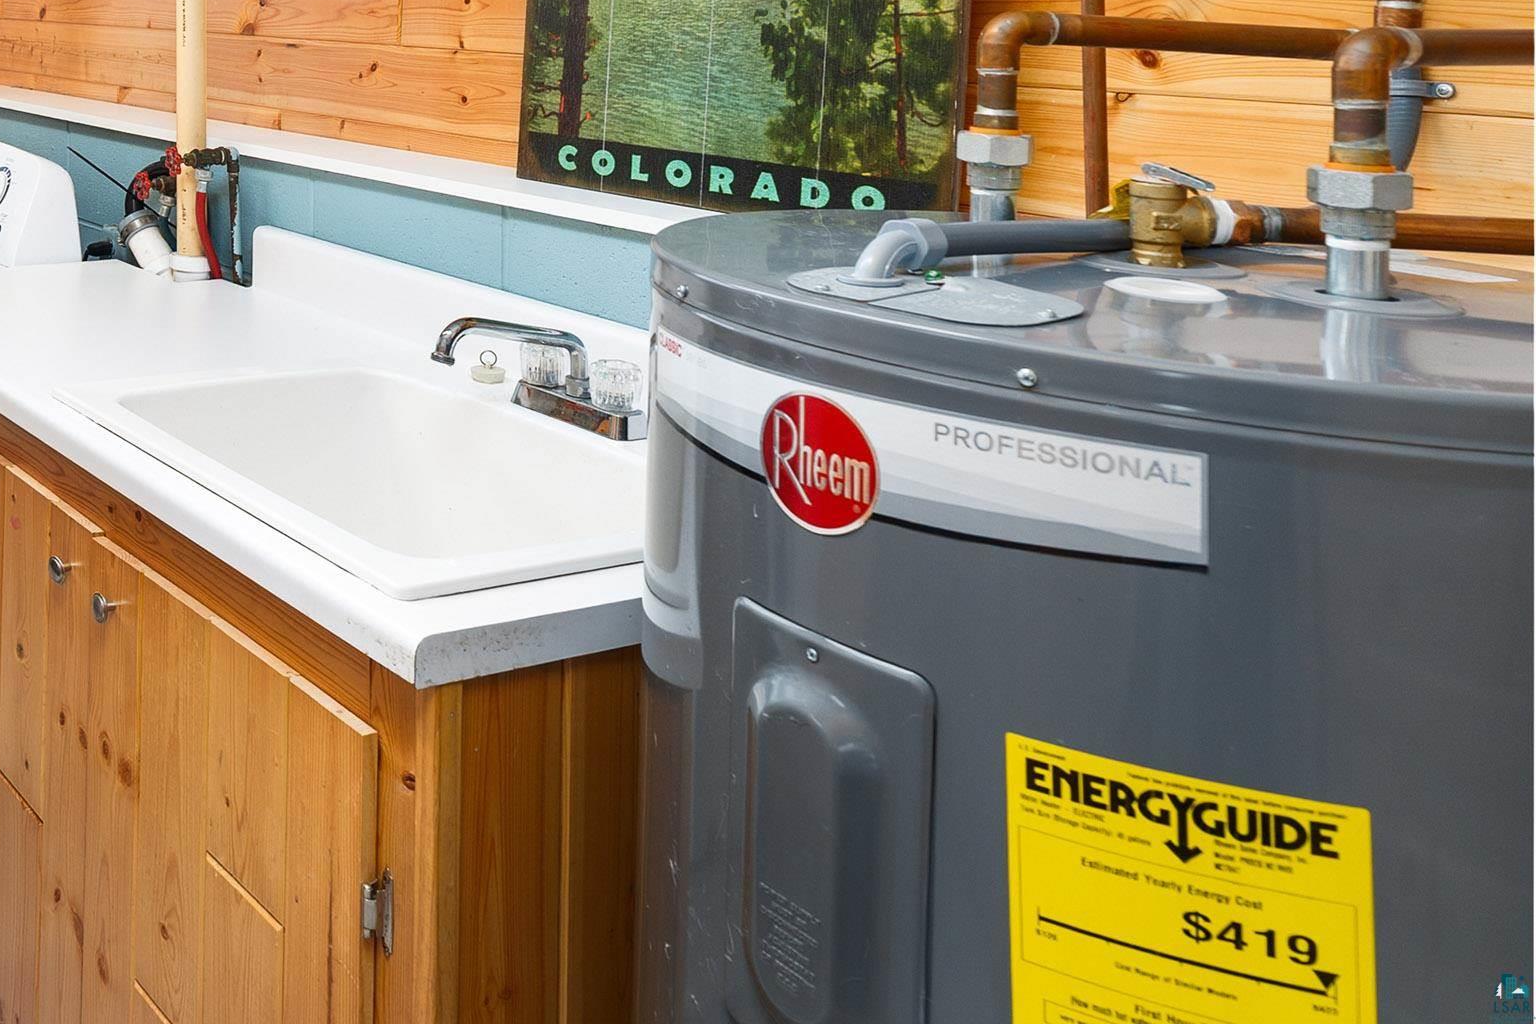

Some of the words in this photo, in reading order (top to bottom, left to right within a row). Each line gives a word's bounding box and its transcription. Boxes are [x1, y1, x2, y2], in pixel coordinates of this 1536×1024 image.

[558, 144, 885, 211] COLORADO
[773, 395, 870, 506] Rheem
[934, 422, 1191, 487] PROFESSIONAL
[1025, 757, 1340, 863] ENERGYGUIDE
[1080, 856, 1139, 881] Estimated
[1144, 874, 1182, 894] Yearly
[1187, 884, 1231, 905] Energy
[1235, 895, 1263, 910] Cost
[1181, 911, 1318, 966] $419
